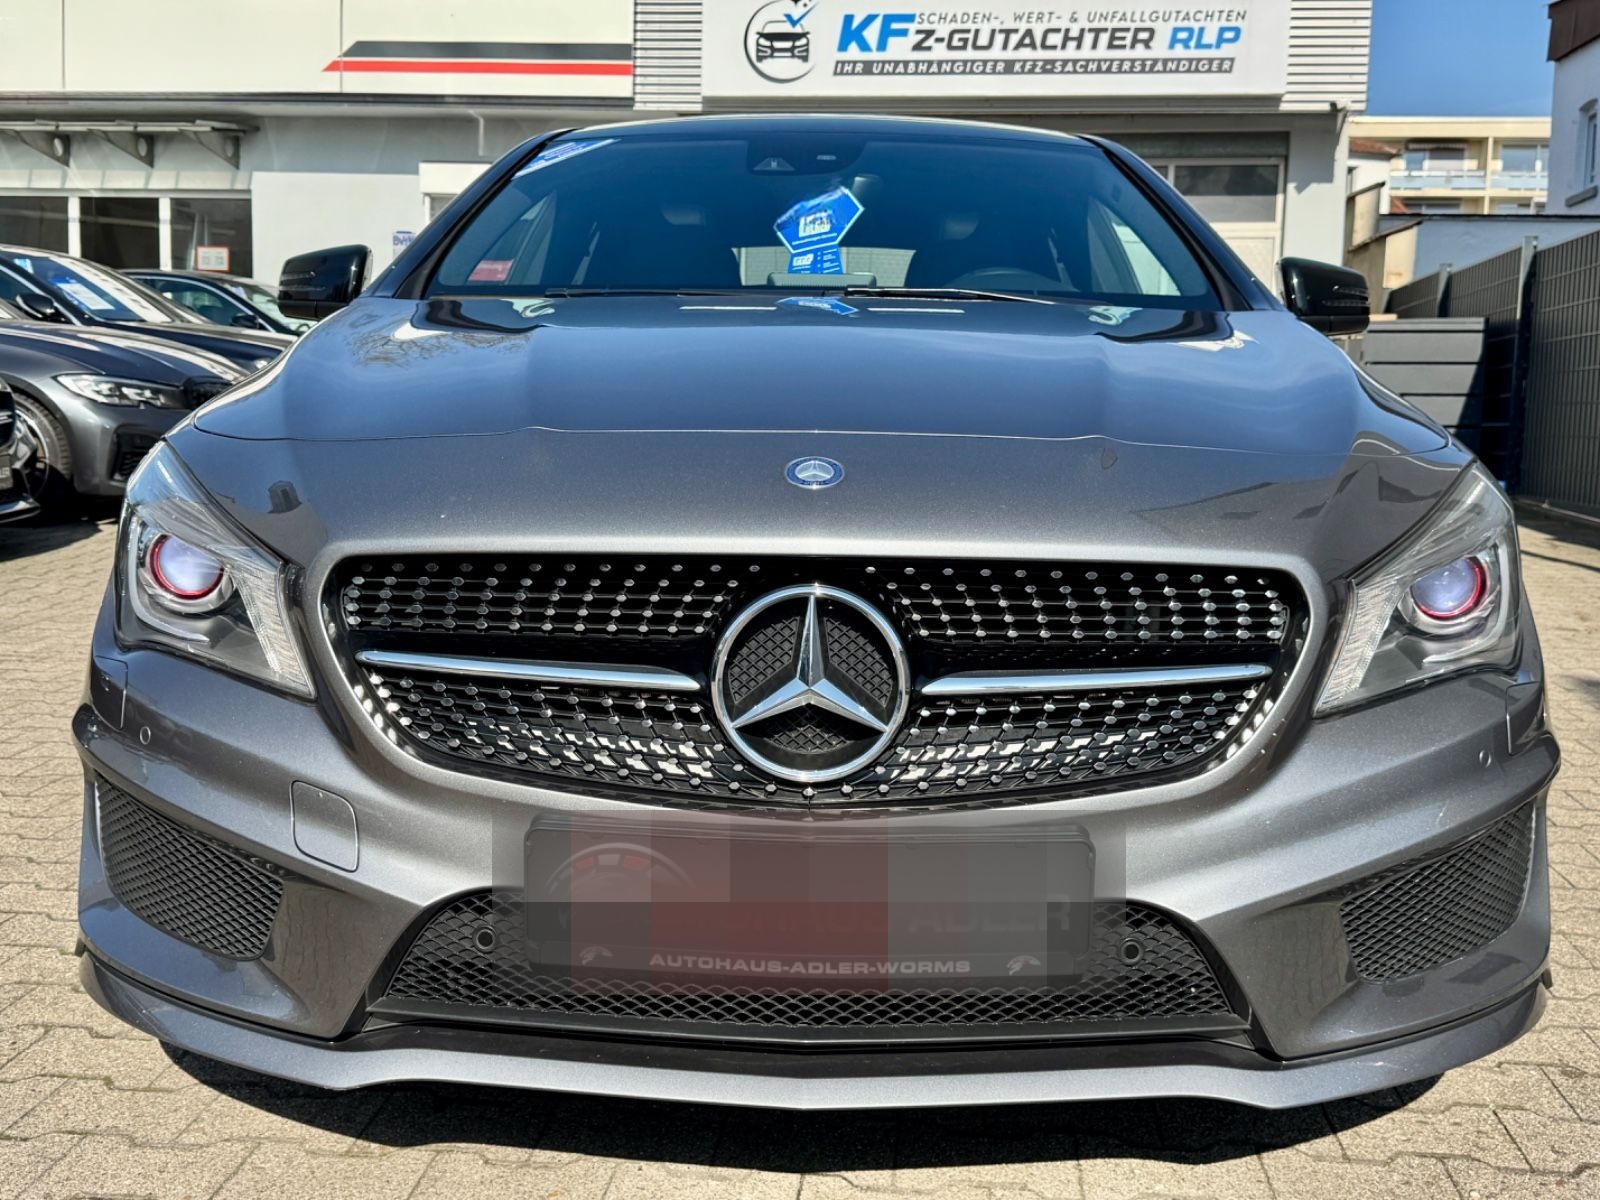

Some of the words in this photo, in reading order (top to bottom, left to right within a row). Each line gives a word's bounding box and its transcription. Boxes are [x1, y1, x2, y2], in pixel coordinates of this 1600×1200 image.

[1013, 11, 1062, 24] WERT-
[1068, 11, 1079, 23] &
[1087, 10, 1247, 24] UNFALLGUTACHTEN
[1168, 26, 1241, 50] RLP
[836, 62, 864, 74] IHR
[872, 60, 1006, 74] UNABHÄNGIGER
[1013, 59, 1232, 74] KFZ-SACHVERSTÄNDIGER
[649, 953, 971, 975] AUTOHAUS-ADLER-WORMS
